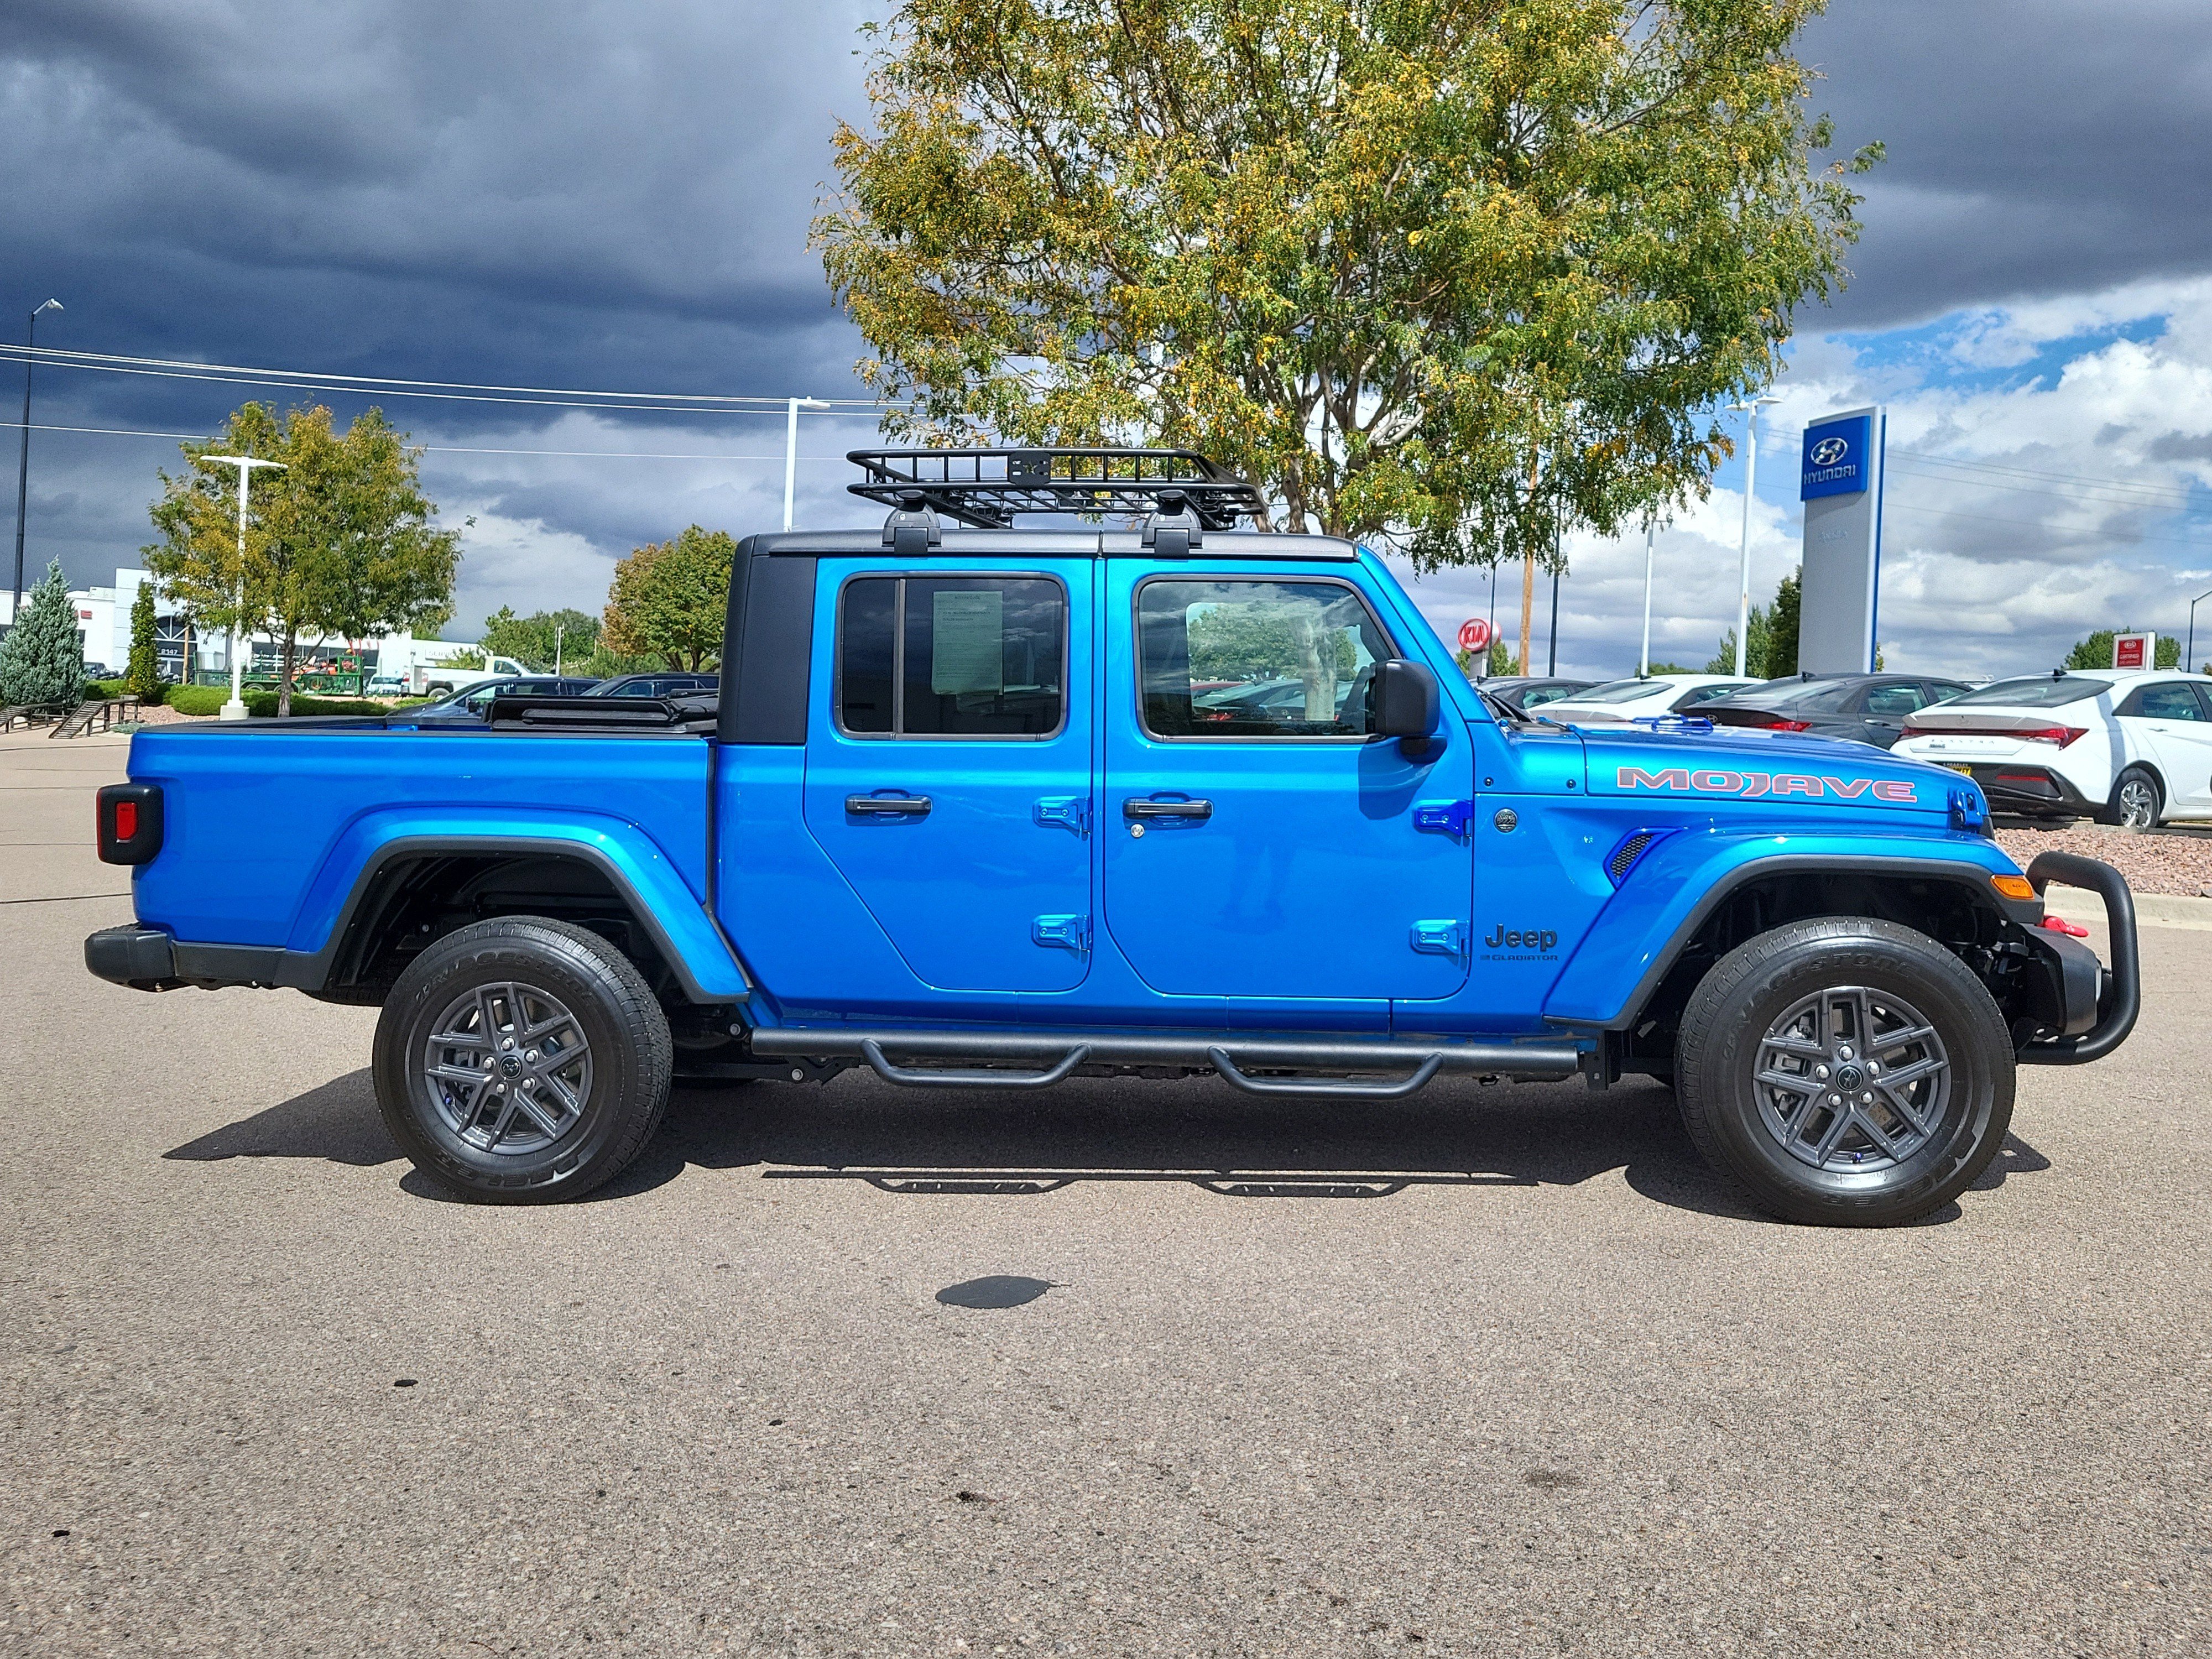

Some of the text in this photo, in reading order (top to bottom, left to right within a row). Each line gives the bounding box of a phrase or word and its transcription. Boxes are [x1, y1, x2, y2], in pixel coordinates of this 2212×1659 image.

[1803, 464, 1856, 485] HYUNDAI
[1616, 767, 1918, 803] MOJAVE
[1485, 924, 1557, 952] Jeep
